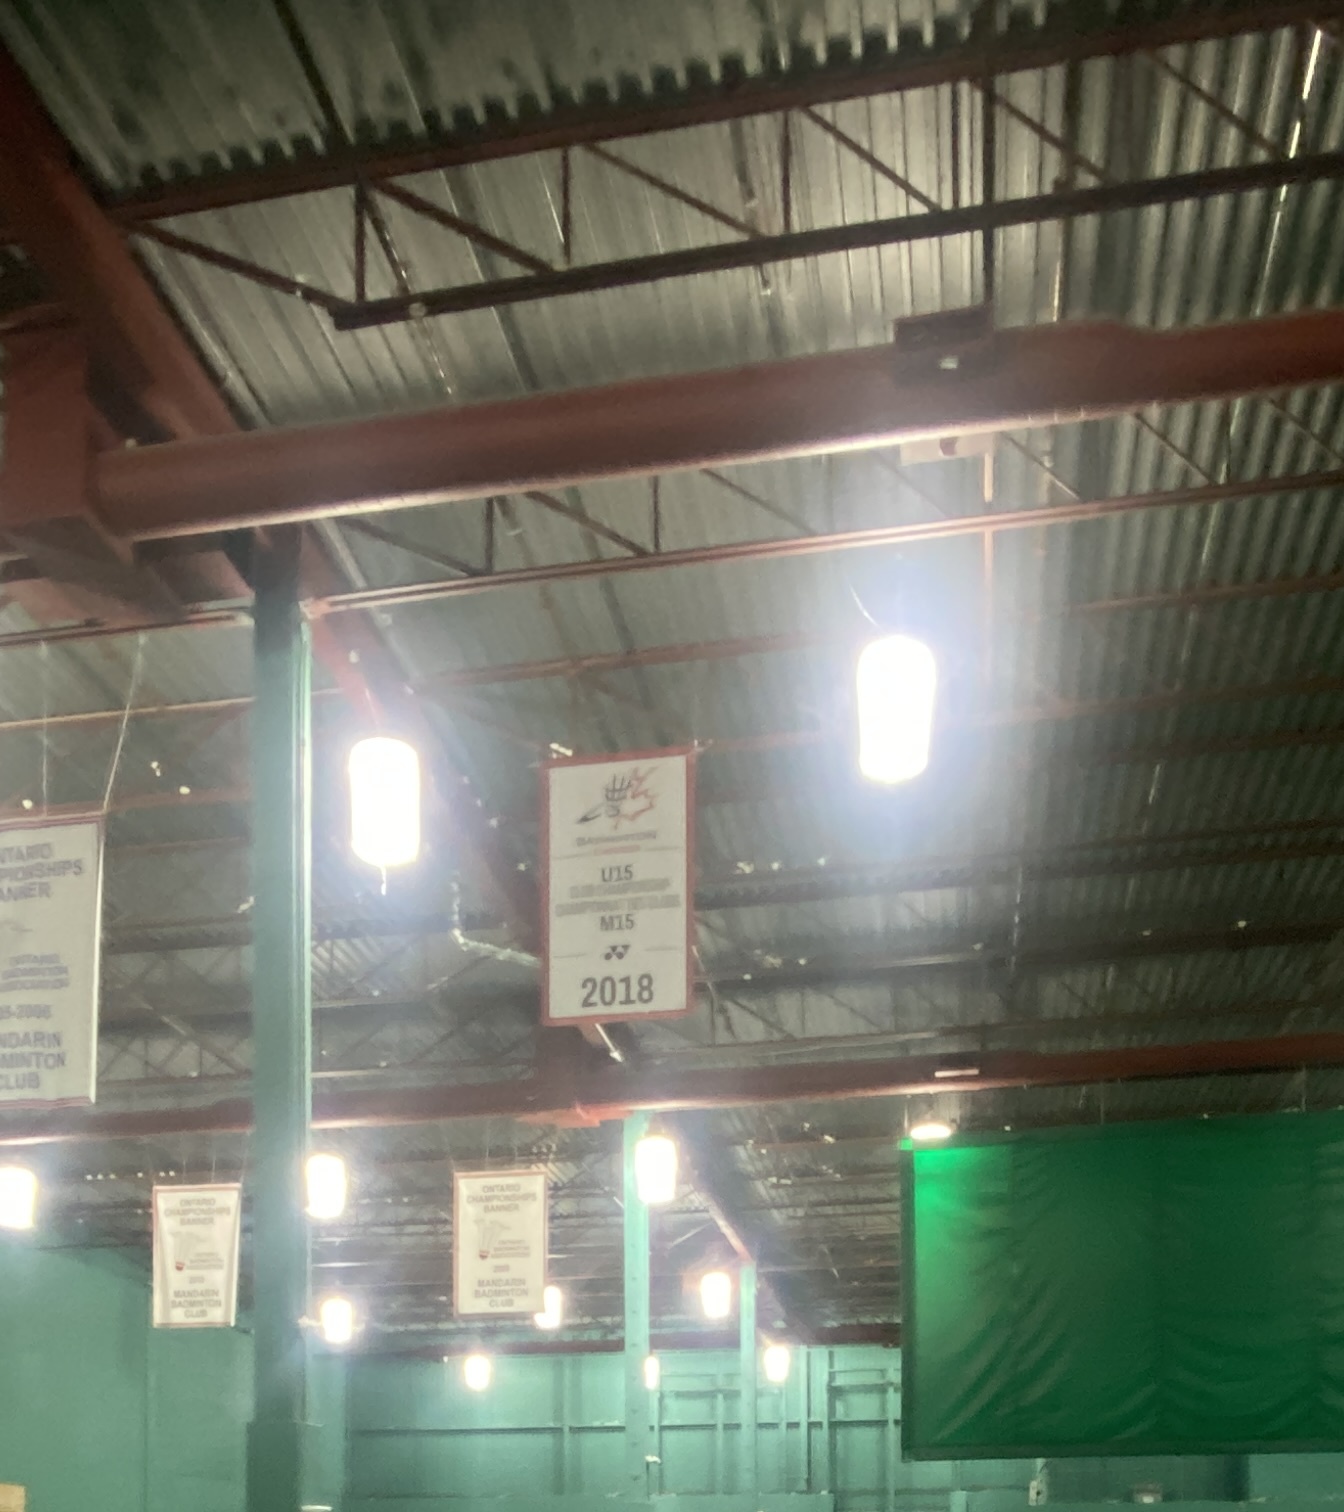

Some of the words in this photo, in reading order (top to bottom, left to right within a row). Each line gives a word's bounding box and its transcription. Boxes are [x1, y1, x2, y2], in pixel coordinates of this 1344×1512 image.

[601, 864, 633, 883] U15
[600, 914, 634, 931] M15
[581, 973, 654, 1008] 2018
